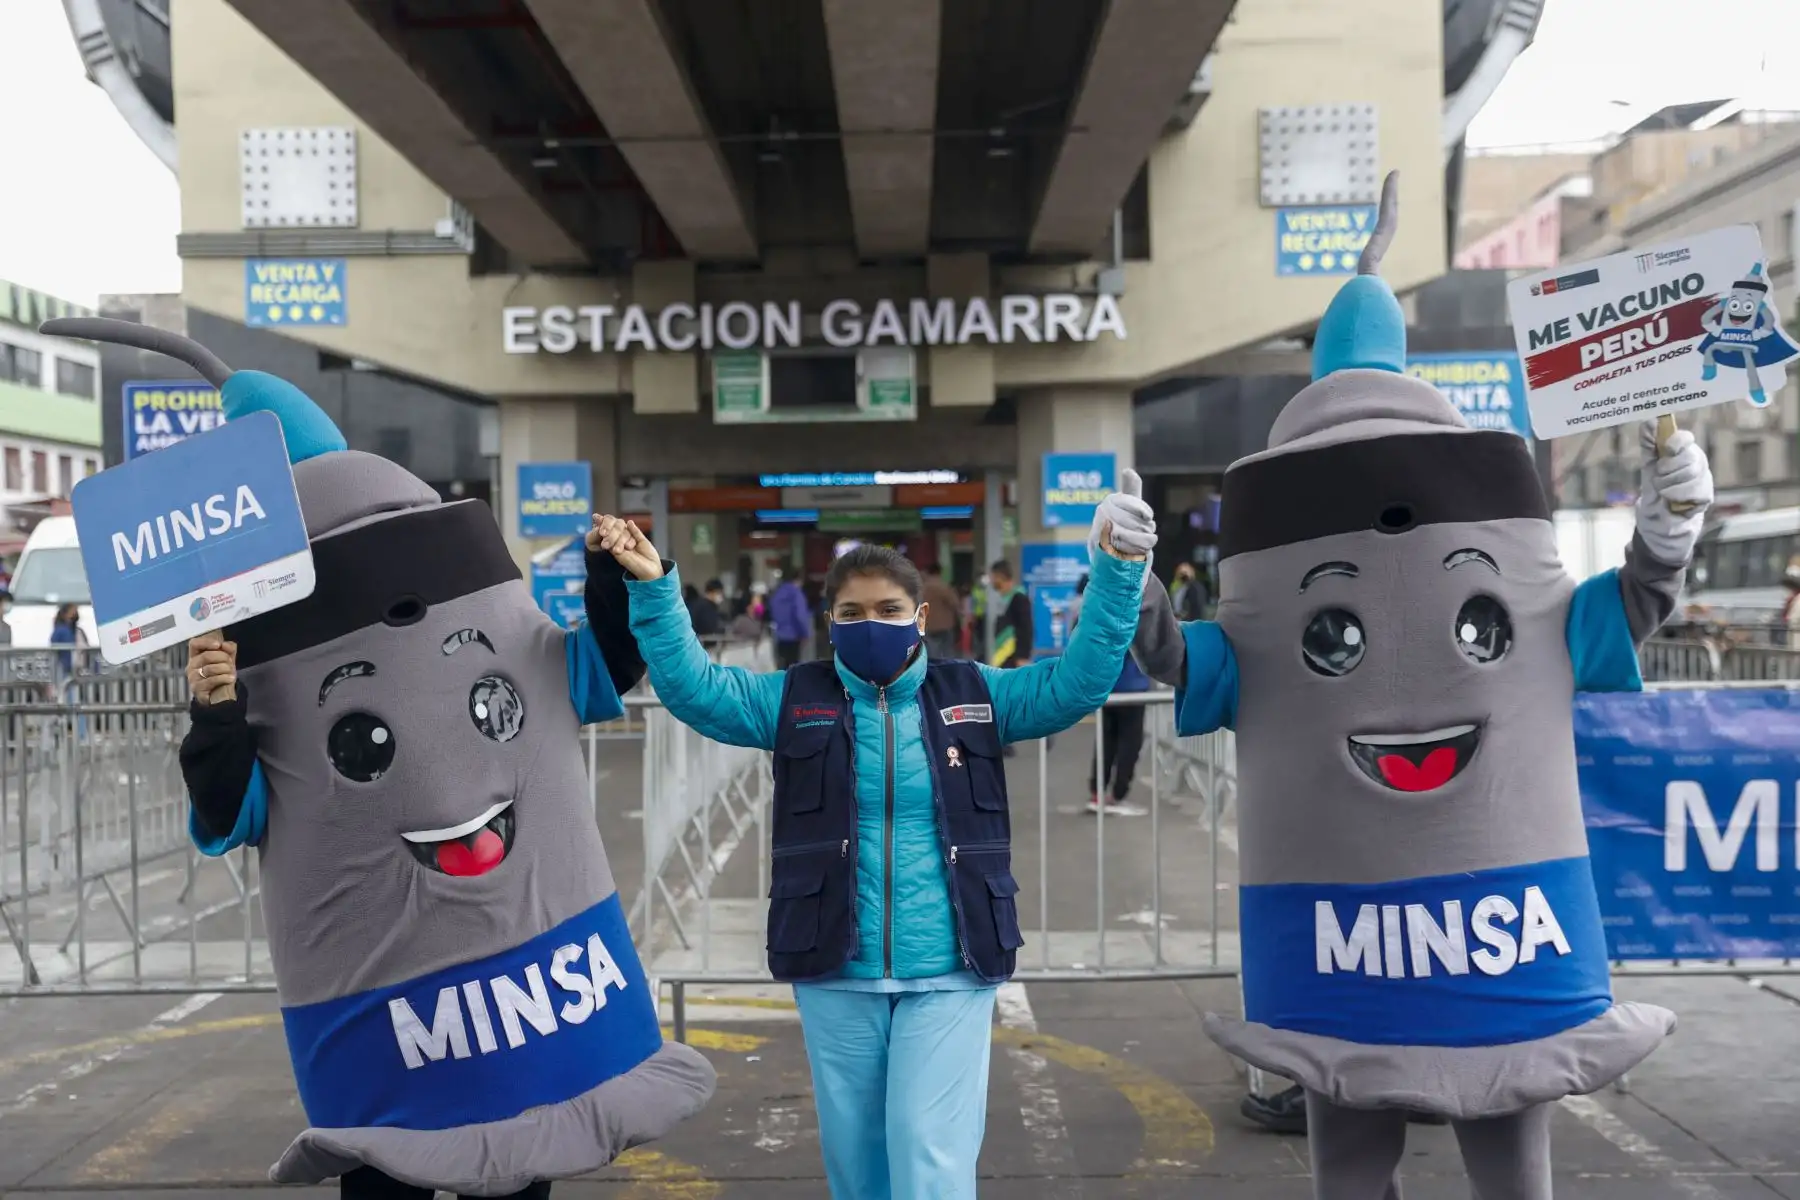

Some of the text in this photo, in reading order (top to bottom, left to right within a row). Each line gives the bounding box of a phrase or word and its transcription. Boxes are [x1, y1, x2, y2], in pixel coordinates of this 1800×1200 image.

[1285, 210, 1369, 231] VENTA Y
[255, 263, 337, 283] VENTA Y
[250, 284, 341, 304] RECARGA
[503, 295, 1127, 354] ESTACION GAMARRA
[1529, 273, 1704, 350] ME VACUNO
[1580, 311, 1669, 370] PERÚ
[1720, 332, 1752, 342] MINSA
[1405, 361, 1511, 386] OHIBIDA
[1573, 344, 1693, 391] COMPLETA TUS DOSIS
[1566, 390, 1708, 426] vacunación más cercano
[1582, 382, 1686, 411] Acude al centro de
[134, 411, 173, 434] LA
[533, 481, 576, 500] SOLO
[1057, 471, 1102, 489] SOLO
[111, 484, 266, 572] MINSA
[1664, 779, 1800, 872] M
[1315, 885, 1571, 979] MINSA
[388, 932, 628, 1070] MINSA
